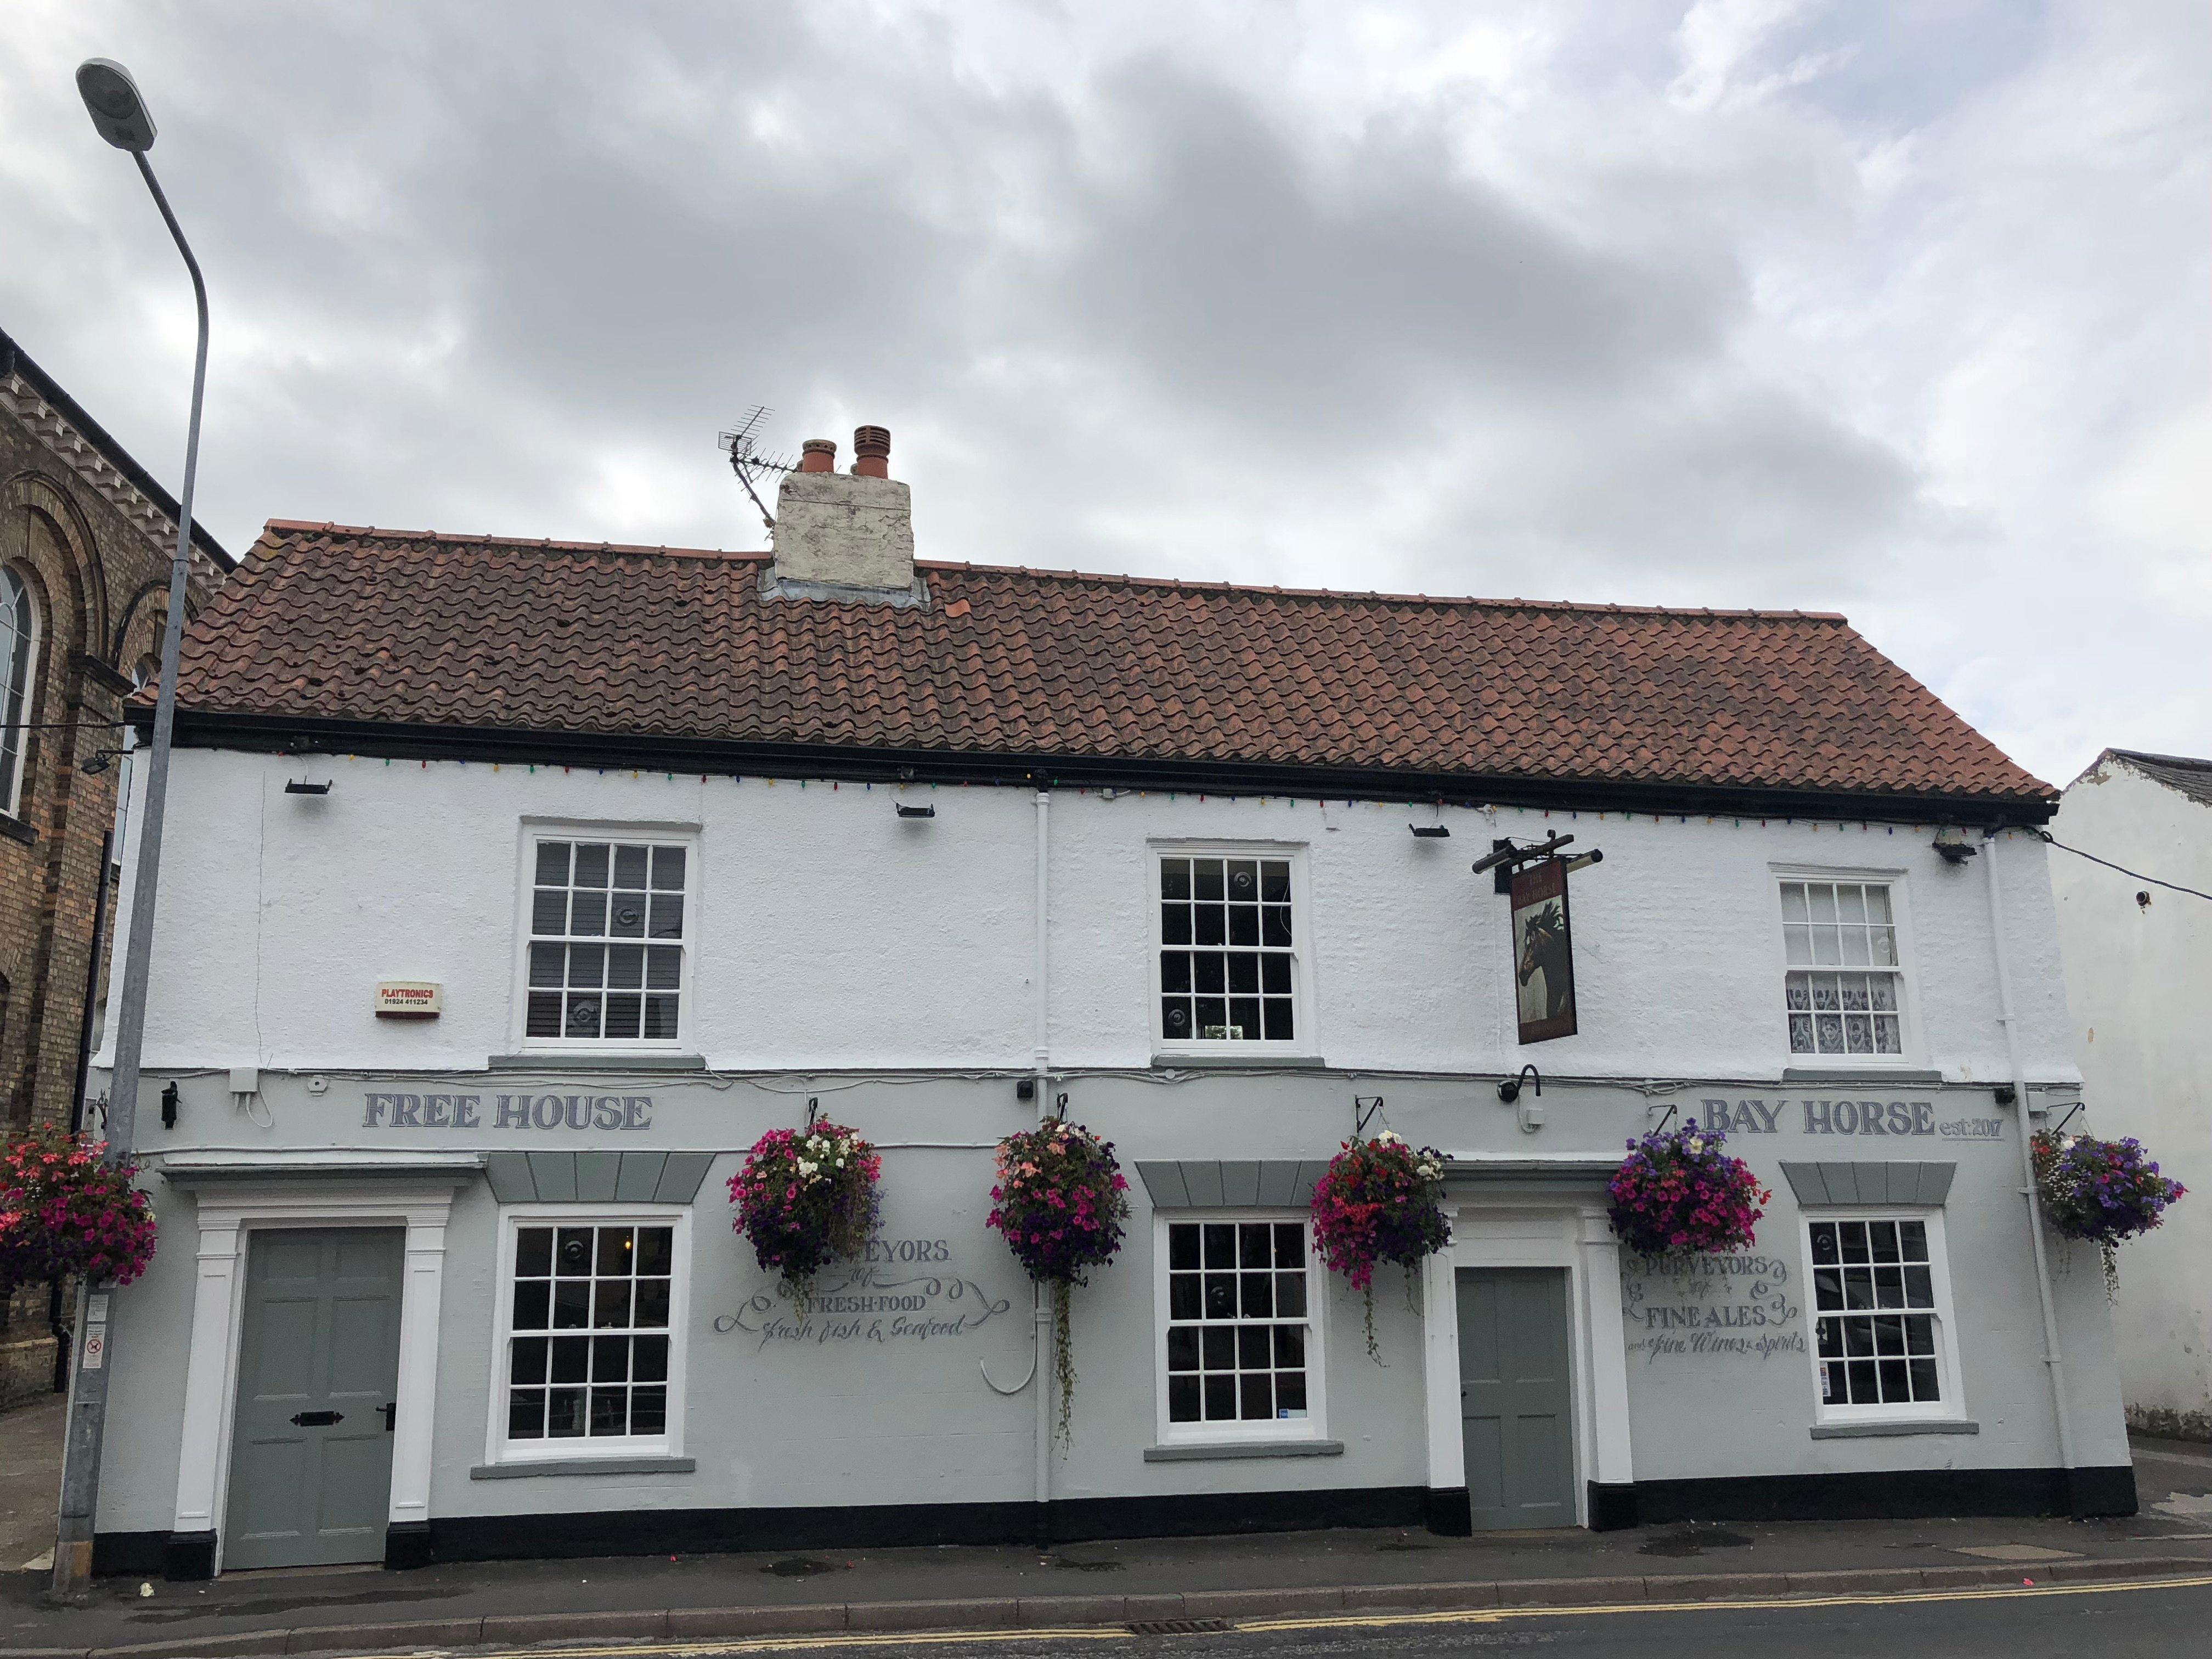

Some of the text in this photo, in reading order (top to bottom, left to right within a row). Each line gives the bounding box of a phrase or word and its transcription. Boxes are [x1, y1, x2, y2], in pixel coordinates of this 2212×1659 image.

[381, 989, 433, 998] PLAYTRONICS
[362, 1093, 653, 1130] FREE HOUSE
[1701, 1098, 1790, 1133] BAY
[1802, 1100, 1935, 1136] HORSE
[1645, 1306, 1766, 1329] FINE ALES
